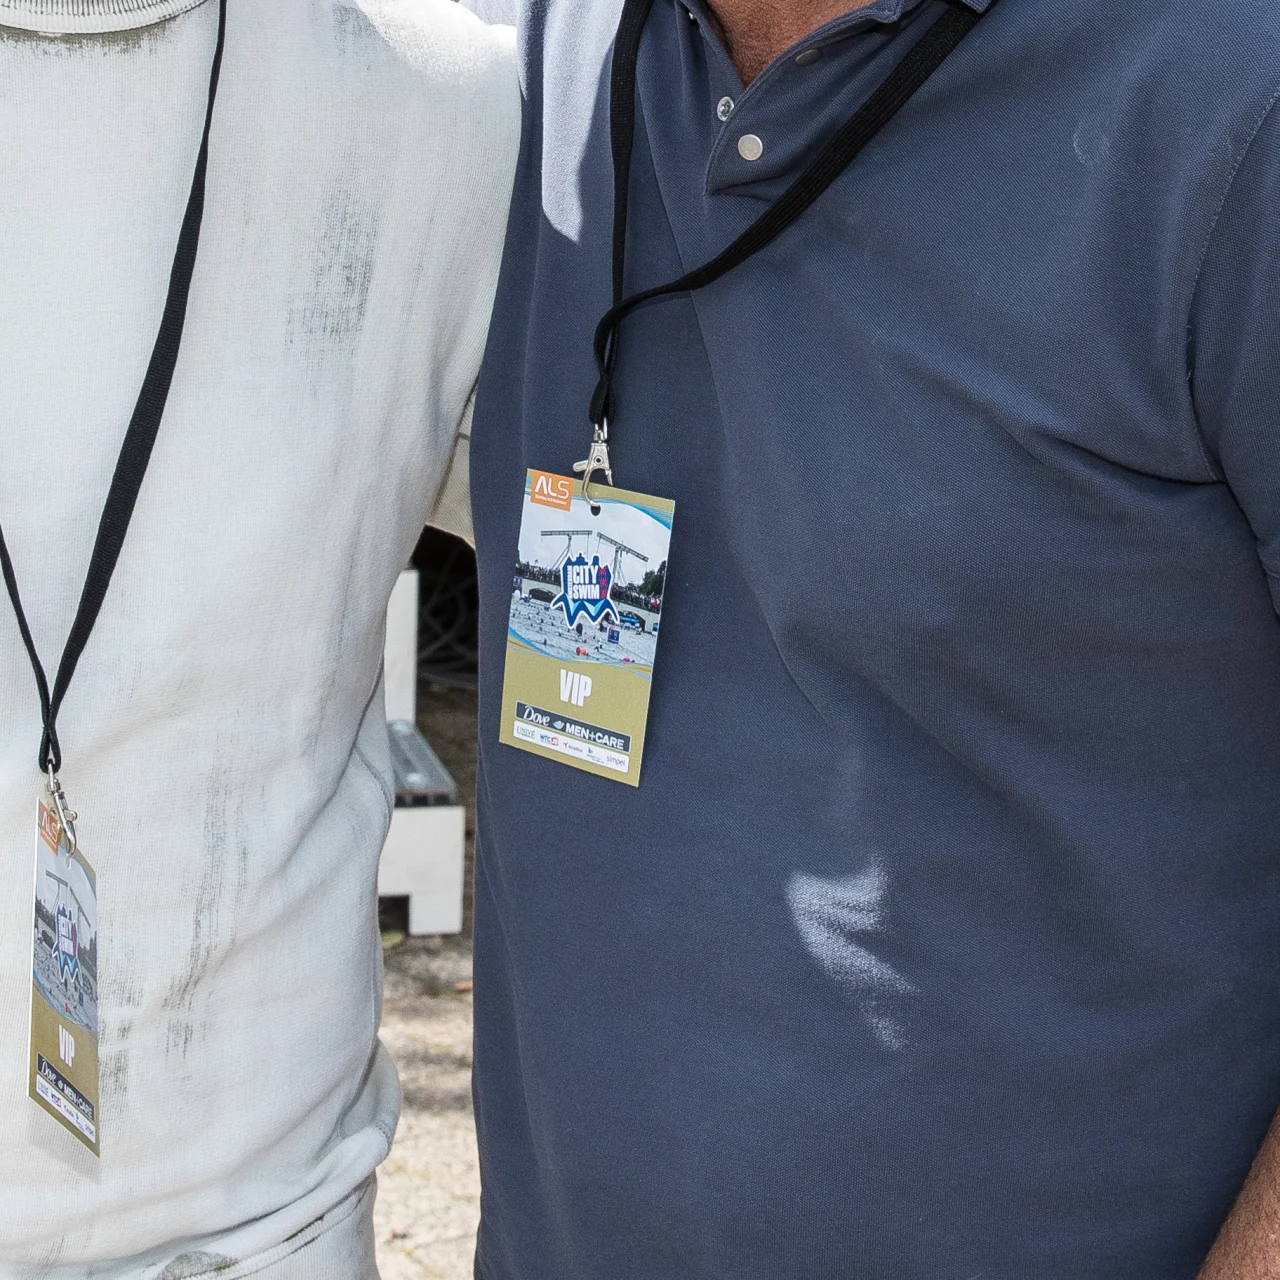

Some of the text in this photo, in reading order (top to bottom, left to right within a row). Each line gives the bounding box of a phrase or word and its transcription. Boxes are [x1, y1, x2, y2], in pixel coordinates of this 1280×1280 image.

[535, 475, 569, 499] ALS
[573, 565, 598, 584] CITY
[573, 585, 600, 599] SWIM
[560, 669, 592, 707] VIP
[523, 705, 550, 727] Dove
[565, 723, 625, 750] MEN+CARE
[59, 1024, 75, 1067] VIP
